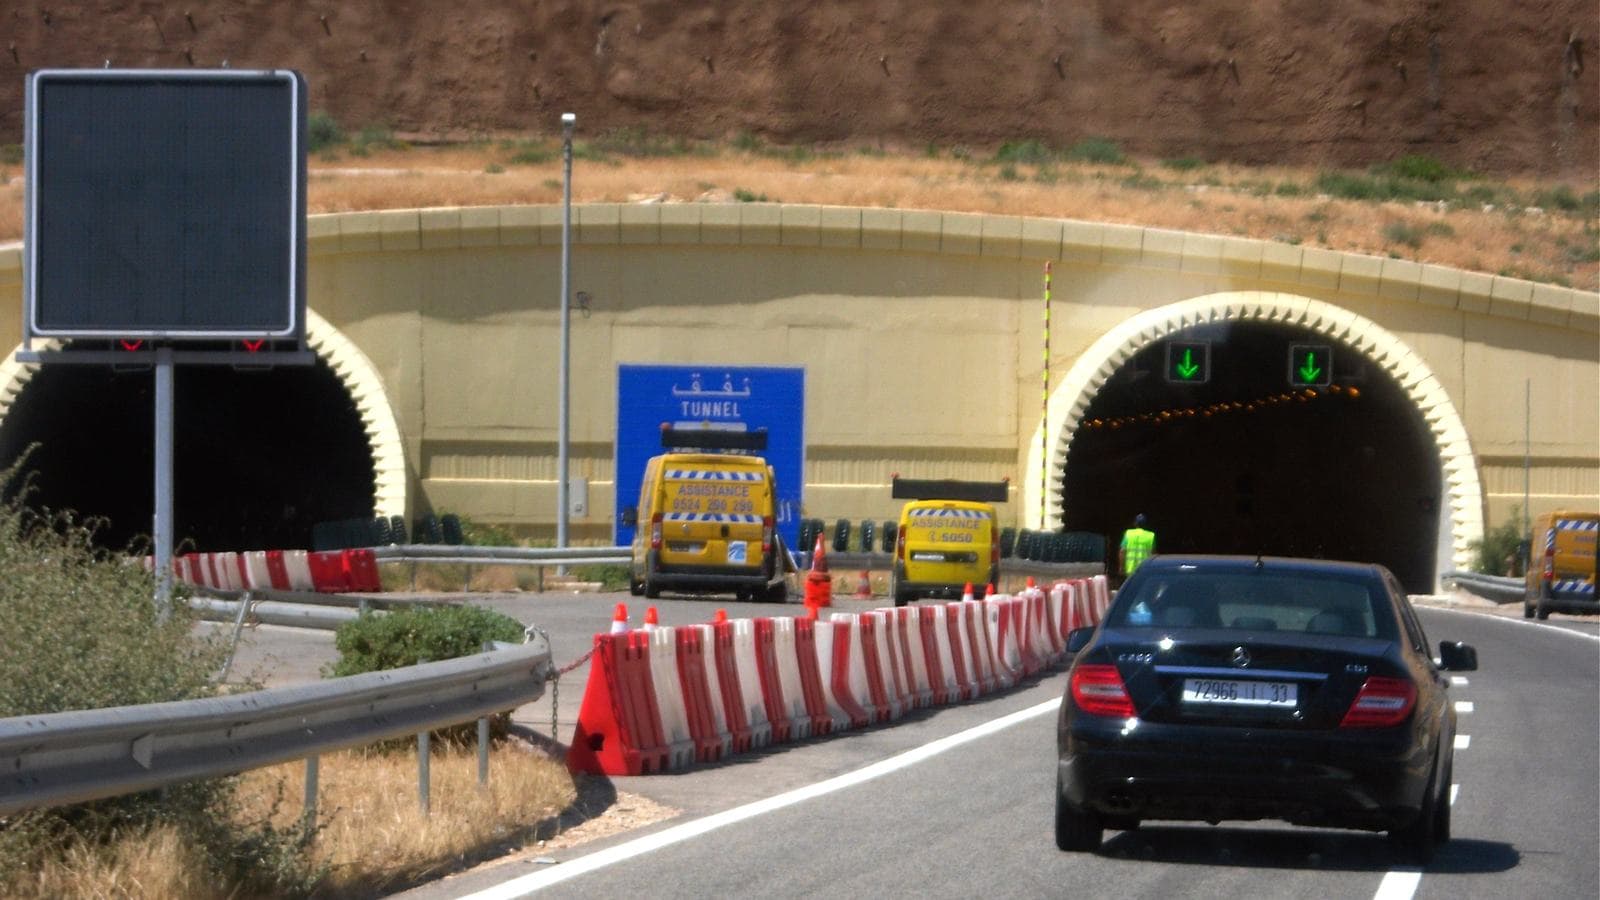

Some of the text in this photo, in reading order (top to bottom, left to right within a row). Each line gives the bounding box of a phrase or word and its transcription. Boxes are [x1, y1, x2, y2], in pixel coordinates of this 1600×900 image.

[681, 401, 741, 417] TUNNEL
[678, 484, 749, 497] ASSISTANCE
[912, 518, 980, 530] ASSISTANCE
[1194, 680, 1238, 700] 72966
[1270, 684, 1288, 703] 33
